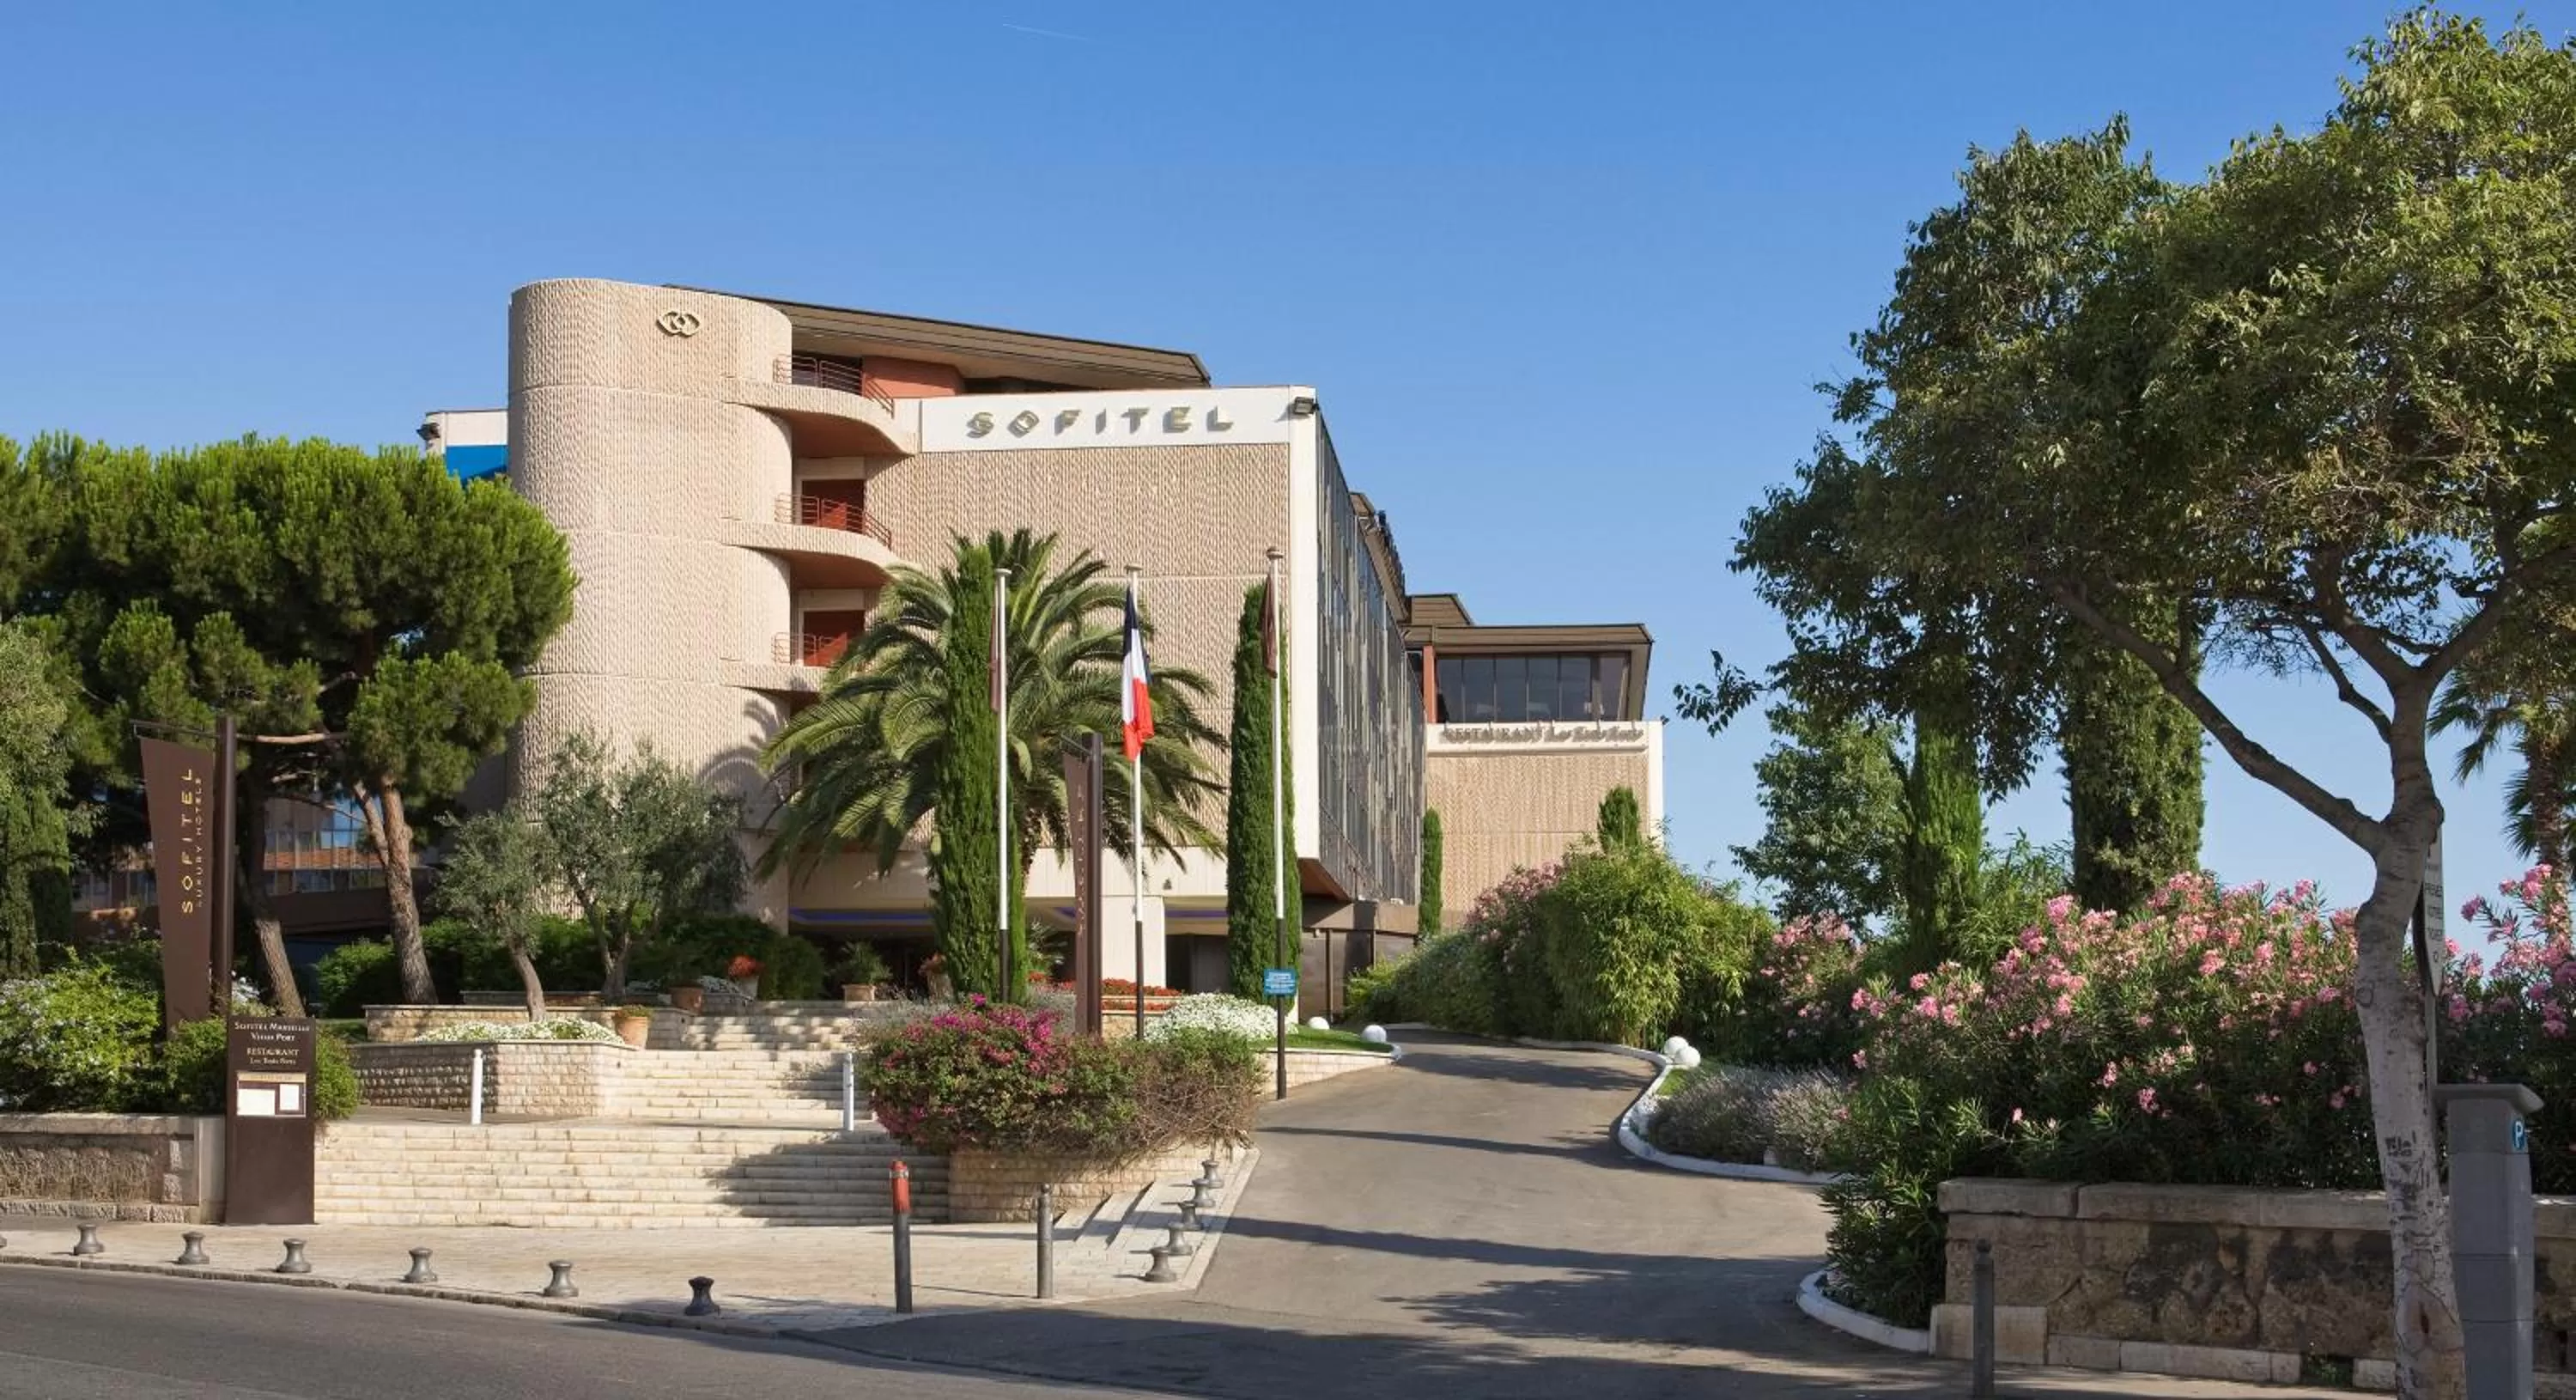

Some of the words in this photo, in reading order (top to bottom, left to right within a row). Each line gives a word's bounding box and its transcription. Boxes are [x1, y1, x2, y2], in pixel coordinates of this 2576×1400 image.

[967, 406, 1235, 439] SOFITEL
[181, 769, 194, 914] SOFITEL
[246, 1047, 300, 1056] RESTAURANT
[2515, 1121, 2524, 1148] P
